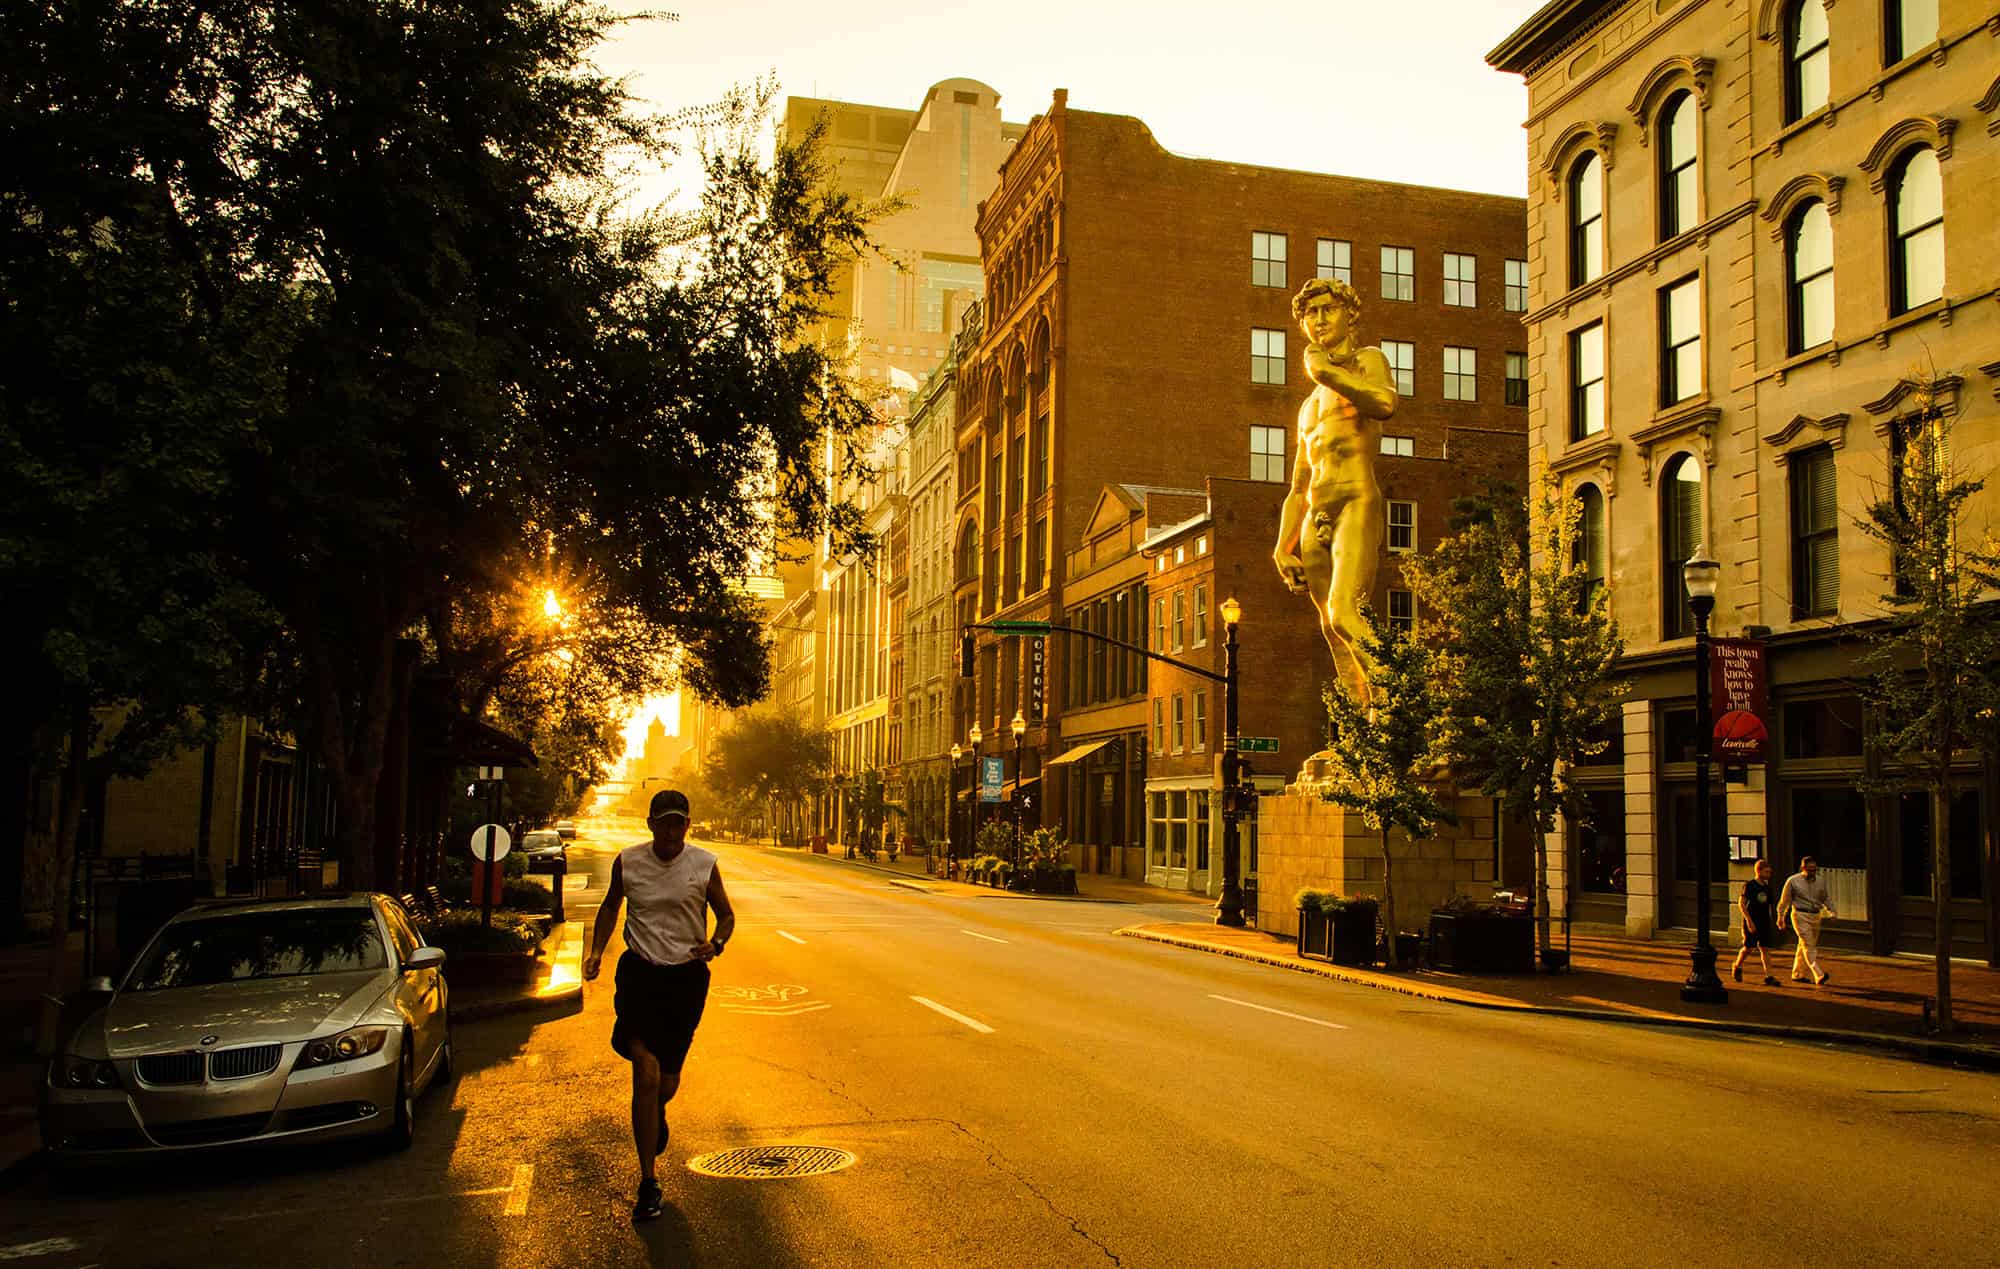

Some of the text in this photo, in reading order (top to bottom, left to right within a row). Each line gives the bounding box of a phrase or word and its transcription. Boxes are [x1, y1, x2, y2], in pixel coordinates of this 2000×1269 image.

[1715, 645, 1759, 659] This town
[1724, 658, 1751, 671] really
[1033, 640, 1043, 711] ORTONS
[1723, 667, 1753, 680] knows
[1724, 678, 1754, 691] how to
[1728, 689, 1751, 701] have
[1726, 702, 1733, 711] a
